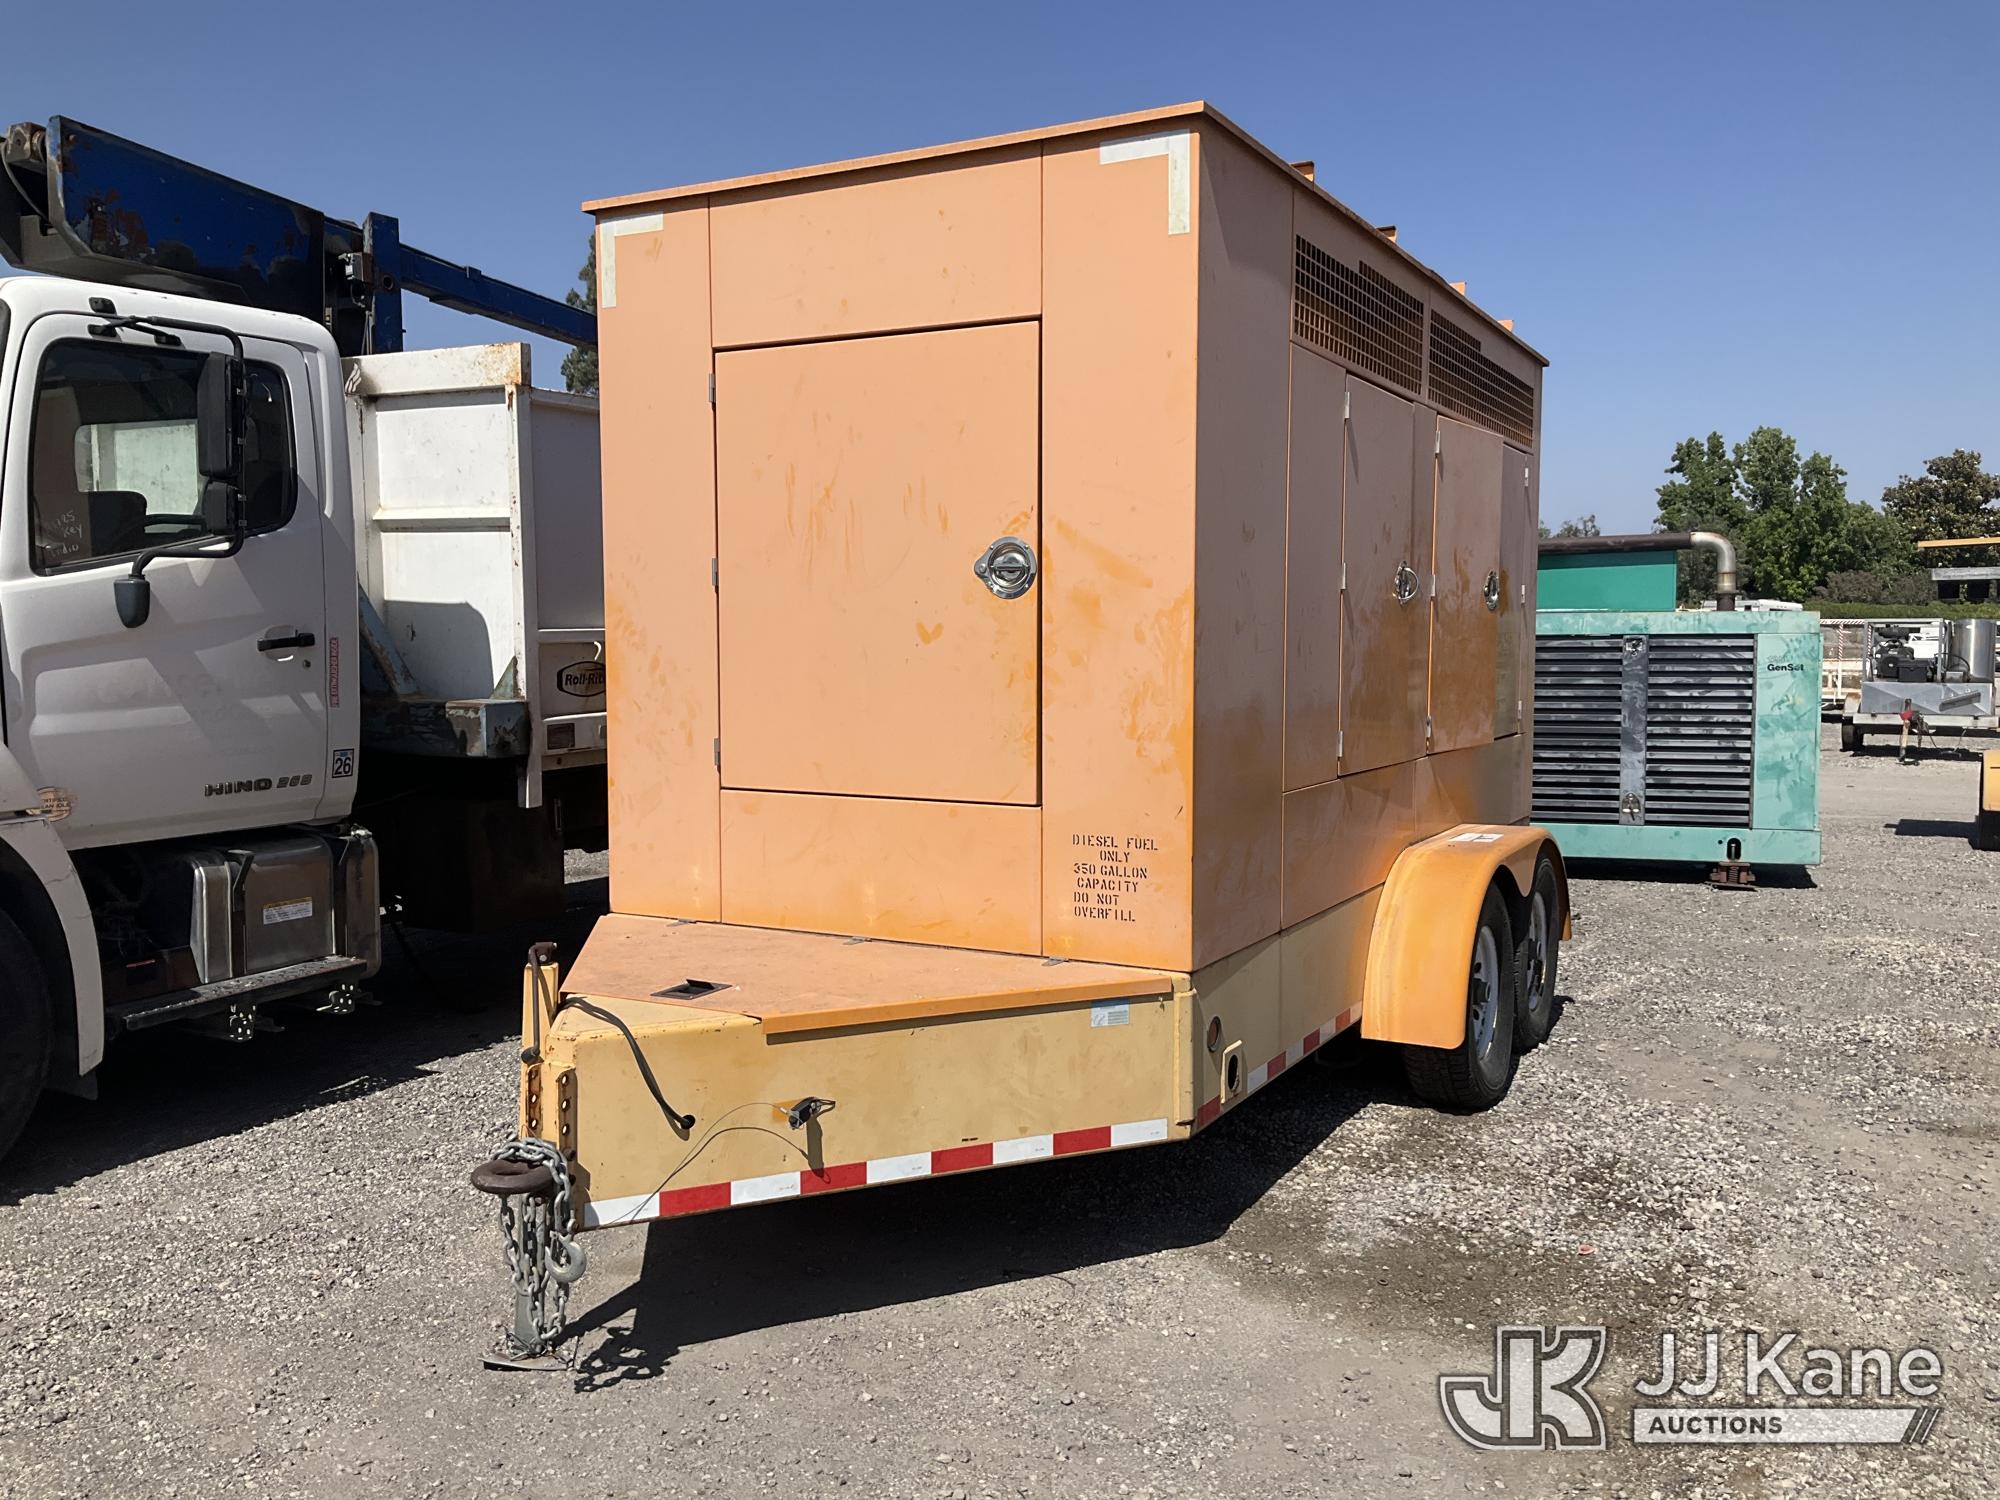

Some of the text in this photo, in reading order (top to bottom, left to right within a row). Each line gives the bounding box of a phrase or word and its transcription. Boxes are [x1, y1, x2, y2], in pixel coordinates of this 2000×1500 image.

[1767, 663, 1804, 671] GenSet
[564, 672, 606, 686] Roll-Rit
[334, 757, 351, 775] 26
[204, 777, 272, 797] HINO
[1072, 834, 1158, 851] DIESEL FUEL
[1099, 850, 1130, 863] ONLY
[1073, 862, 1148, 879] 350 GALLON
[1076, 877, 1138, 893] CAPACITY
[1073, 892, 1119, 906] DO NOT
[1074, 906, 1136, 922] OVERFILL
